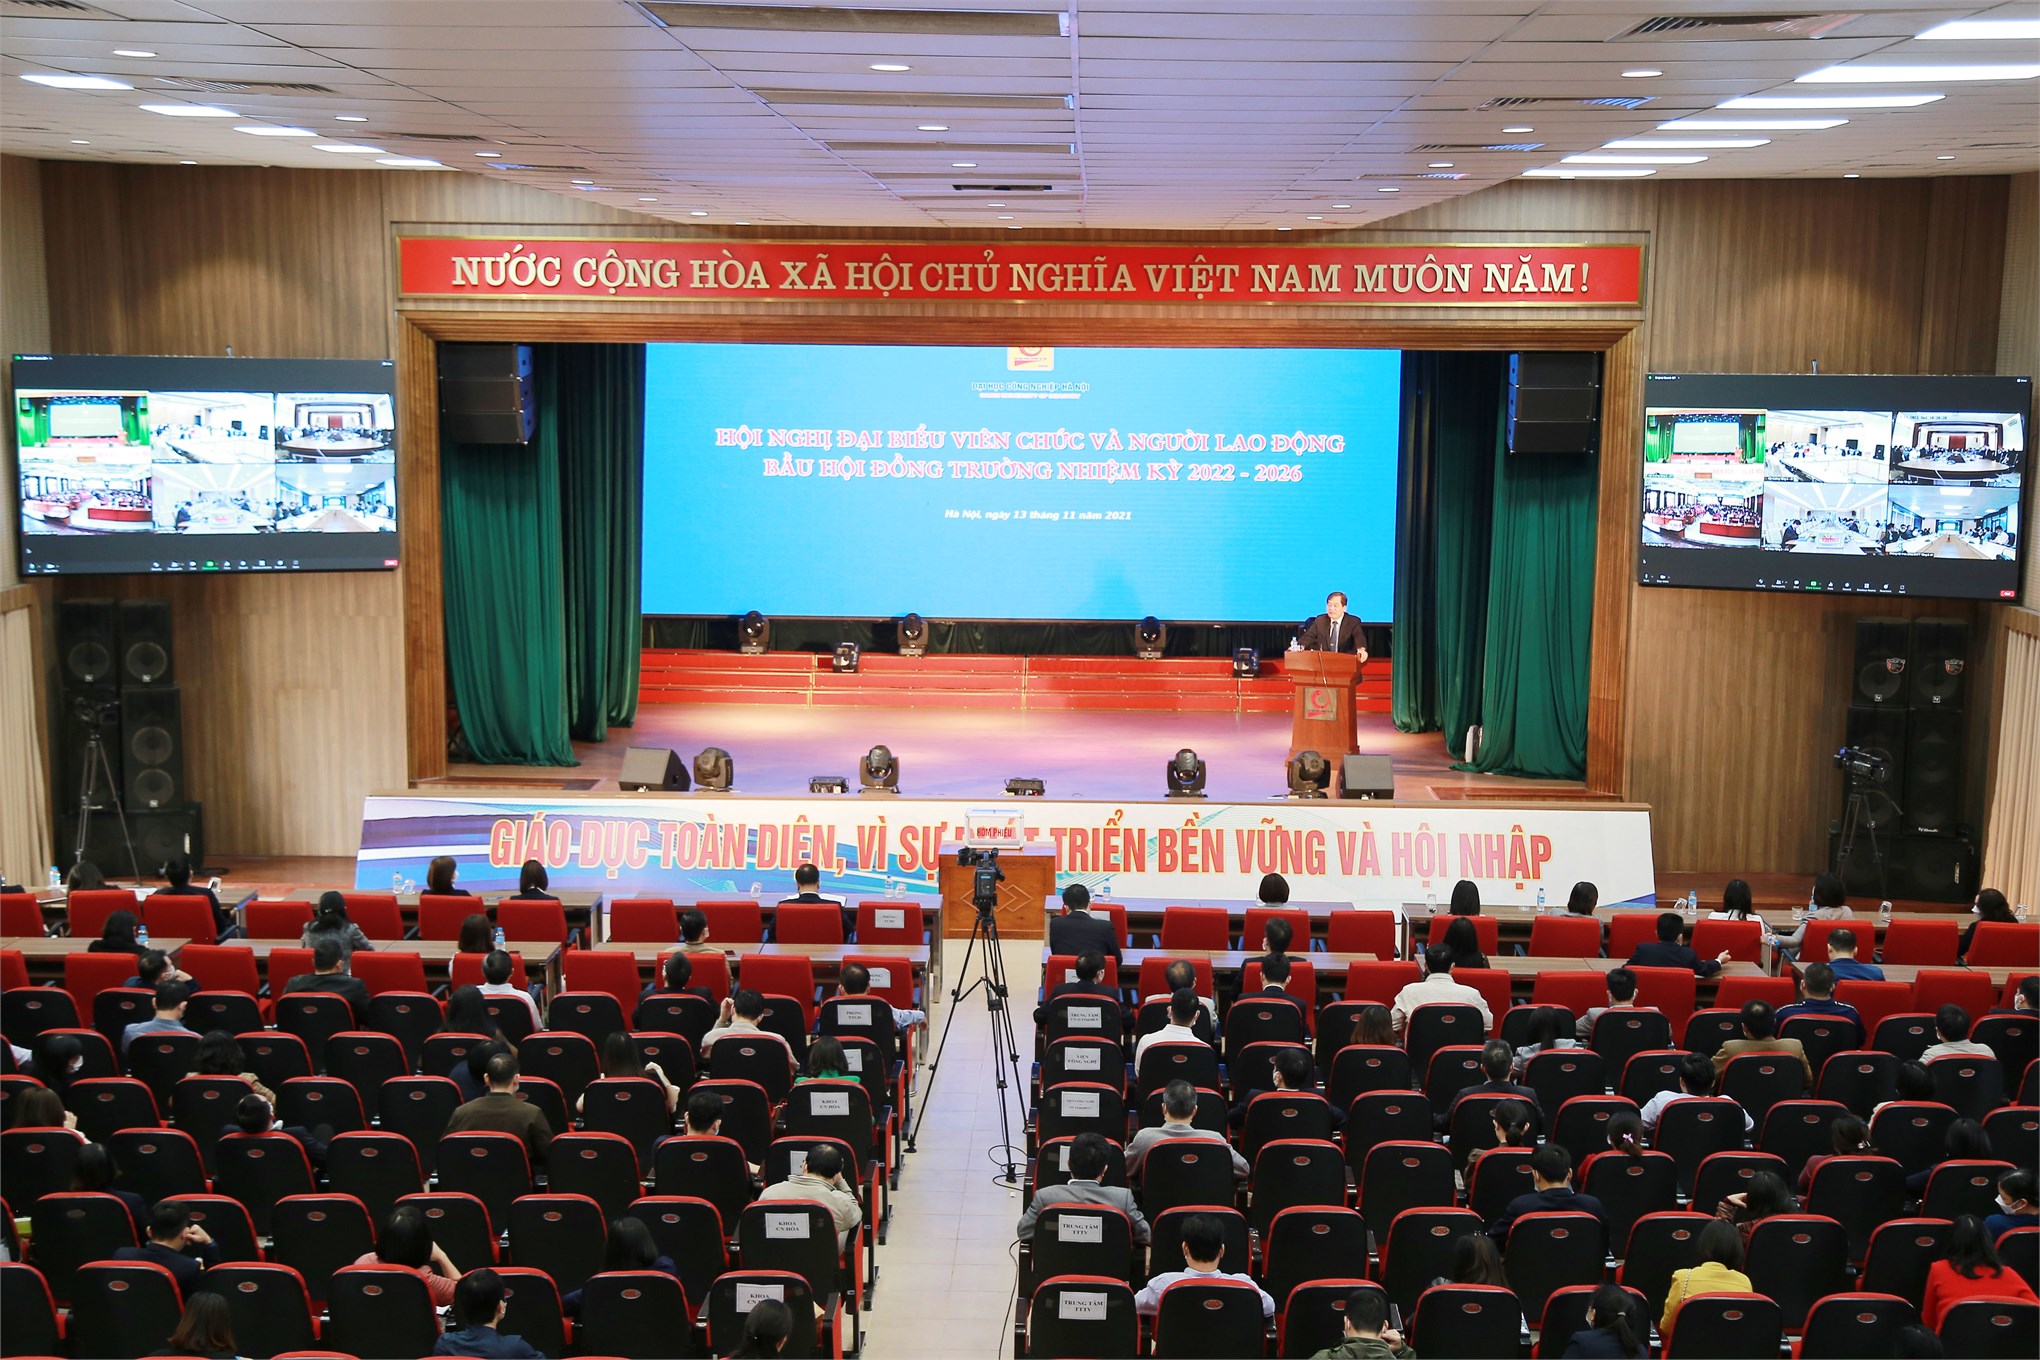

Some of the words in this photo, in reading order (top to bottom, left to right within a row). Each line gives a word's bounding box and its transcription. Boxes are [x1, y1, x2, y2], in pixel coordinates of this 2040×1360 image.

[451, 244, 561, 287] NƯỚC
[572, 248, 681, 295] CỘNG
[690, 250, 770, 290] HÒA
[779, 254, 836, 290] XÃ
[844, 253, 913, 297] HỘI
[920, 250, 1001, 292] CHỦ
[1008, 256, 1136, 293] NGHĨA
[1144, 255, 1240, 300] VIỆT
[1250, 263, 1342, 294] NAM
[1353, 254, 1473, 294] MUÔN
[715, 425, 763, 450] HỘI
[768, 429, 832, 451] NGHỊ
[837, 429, 884, 451] ĐẠI
[887, 423, 946, 449] BIỂU
[951, 428, 1011, 450] VIÊN
[1016, 427, 1085, 451] CHỨC
[1089, 428, 1122, 451] VÀ
[1128, 429, 1209, 452] NGƯỜI
[1214, 433, 1266, 453] LAO
[1271, 430, 1346, 456] ĐỘNG
[763, 451, 814, 477] BẦU
[818, 455, 866, 481] HỘI
[870, 453, 944, 479] ĐỒNG
[949, 457, 1052, 480] TRƯỜNG
[1057, 459, 1141, 484] NHIỆM
[1146, 458, 1183, 481] KỲ
[1188, 464, 1235, 481] 2022
[1254, 464, 1303, 482] 2026
[944, 509, 959, 518] Hà
[961, 508, 982, 521] Nội,
[985, 510, 1010, 521] ngày
[1013, 510, 1027, 519] 13
[1029, 510, 1059, 521] tháng
[1062, 511, 1076, 520] 11
[1078, 511, 1102, 520] năm
[1105, 511, 1132, 520] 2021
[489, 812, 573, 867] GIÁO
[578, 820, 651, 878] DỤC
[658, 813, 749, 869] TOÀN
[857, 815, 892, 871] VÌ
[898, 820, 948, 881] SỰ
[1050, 809, 1147, 873] TRIỂN
[1157, 811, 1227, 875] BỀN
[1236, 818, 1326, 875] VỮNG
[1336, 821, 1381, 877] VÀ
[1391, 823, 1448, 888] HỘI
[1459, 824, 1553, 891] NHẬP
